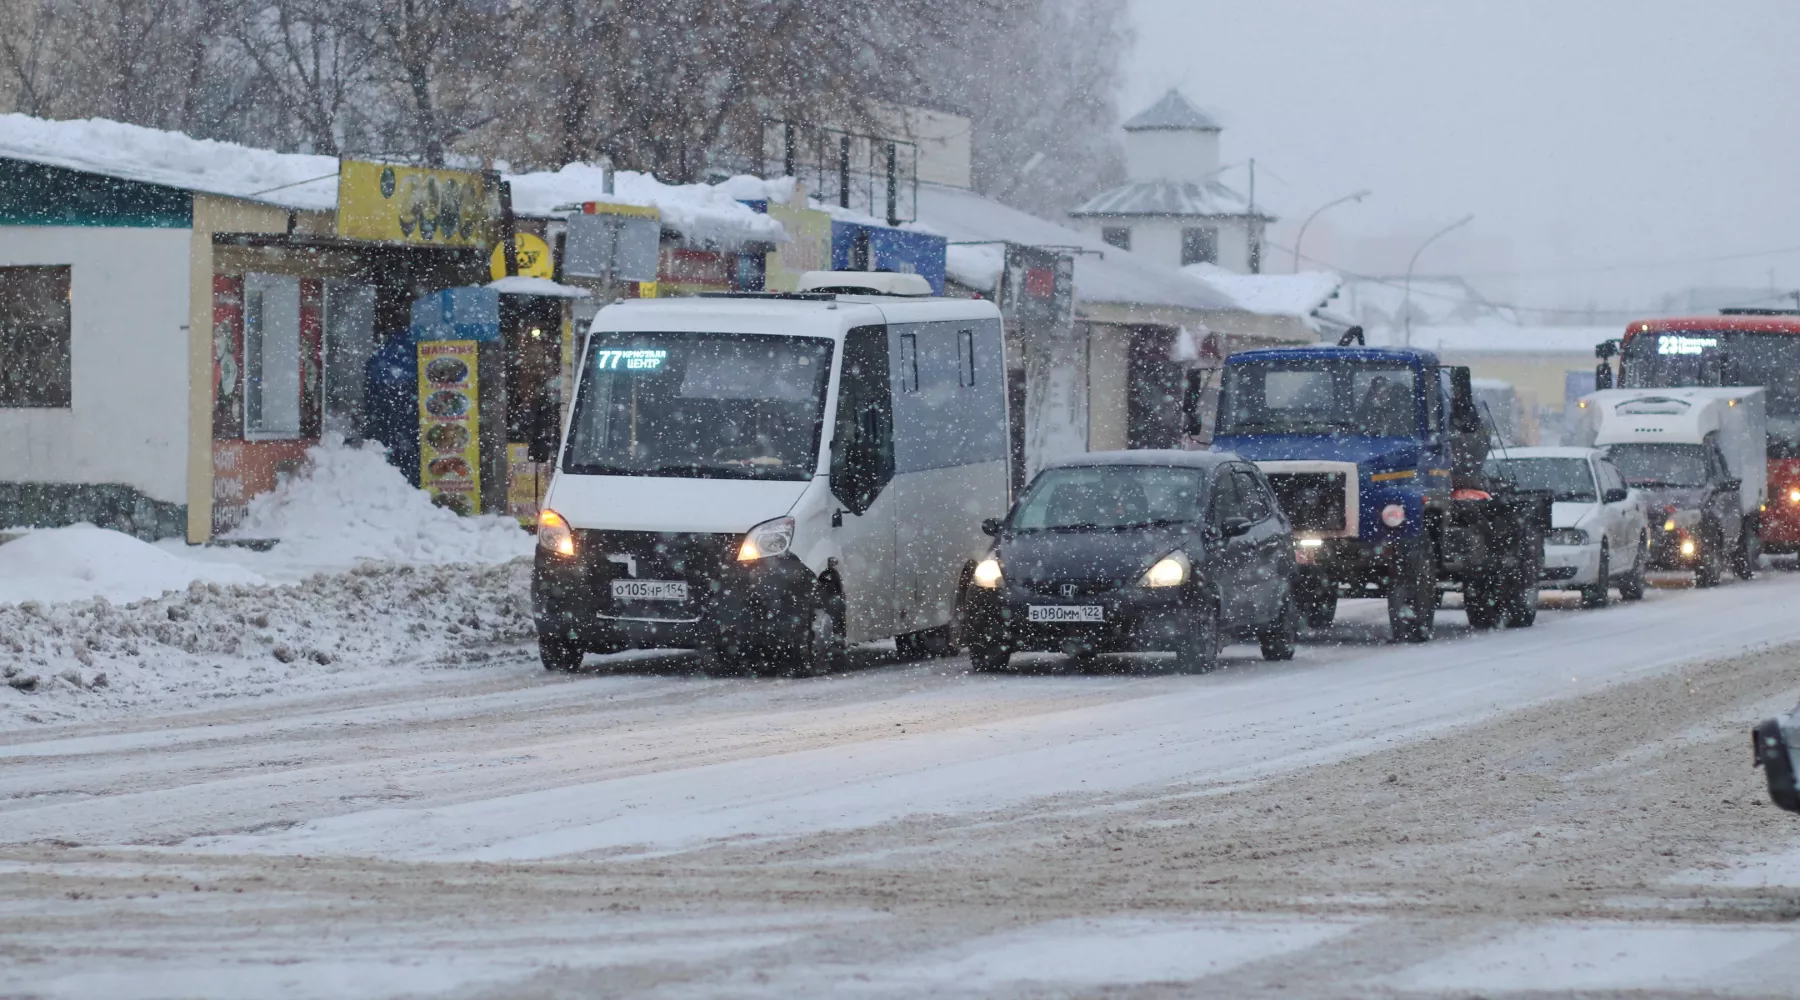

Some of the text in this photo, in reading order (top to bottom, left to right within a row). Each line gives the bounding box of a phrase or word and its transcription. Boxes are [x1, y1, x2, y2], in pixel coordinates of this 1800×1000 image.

[1658, 336, 1678, 354] 23
[599, 350, 622, 369] 77
[627, 359, 661, 369] ЦЕНТР
[666, 584, 685, 594] 154
[1032, 607, 1100, 620] В080ММ 122
